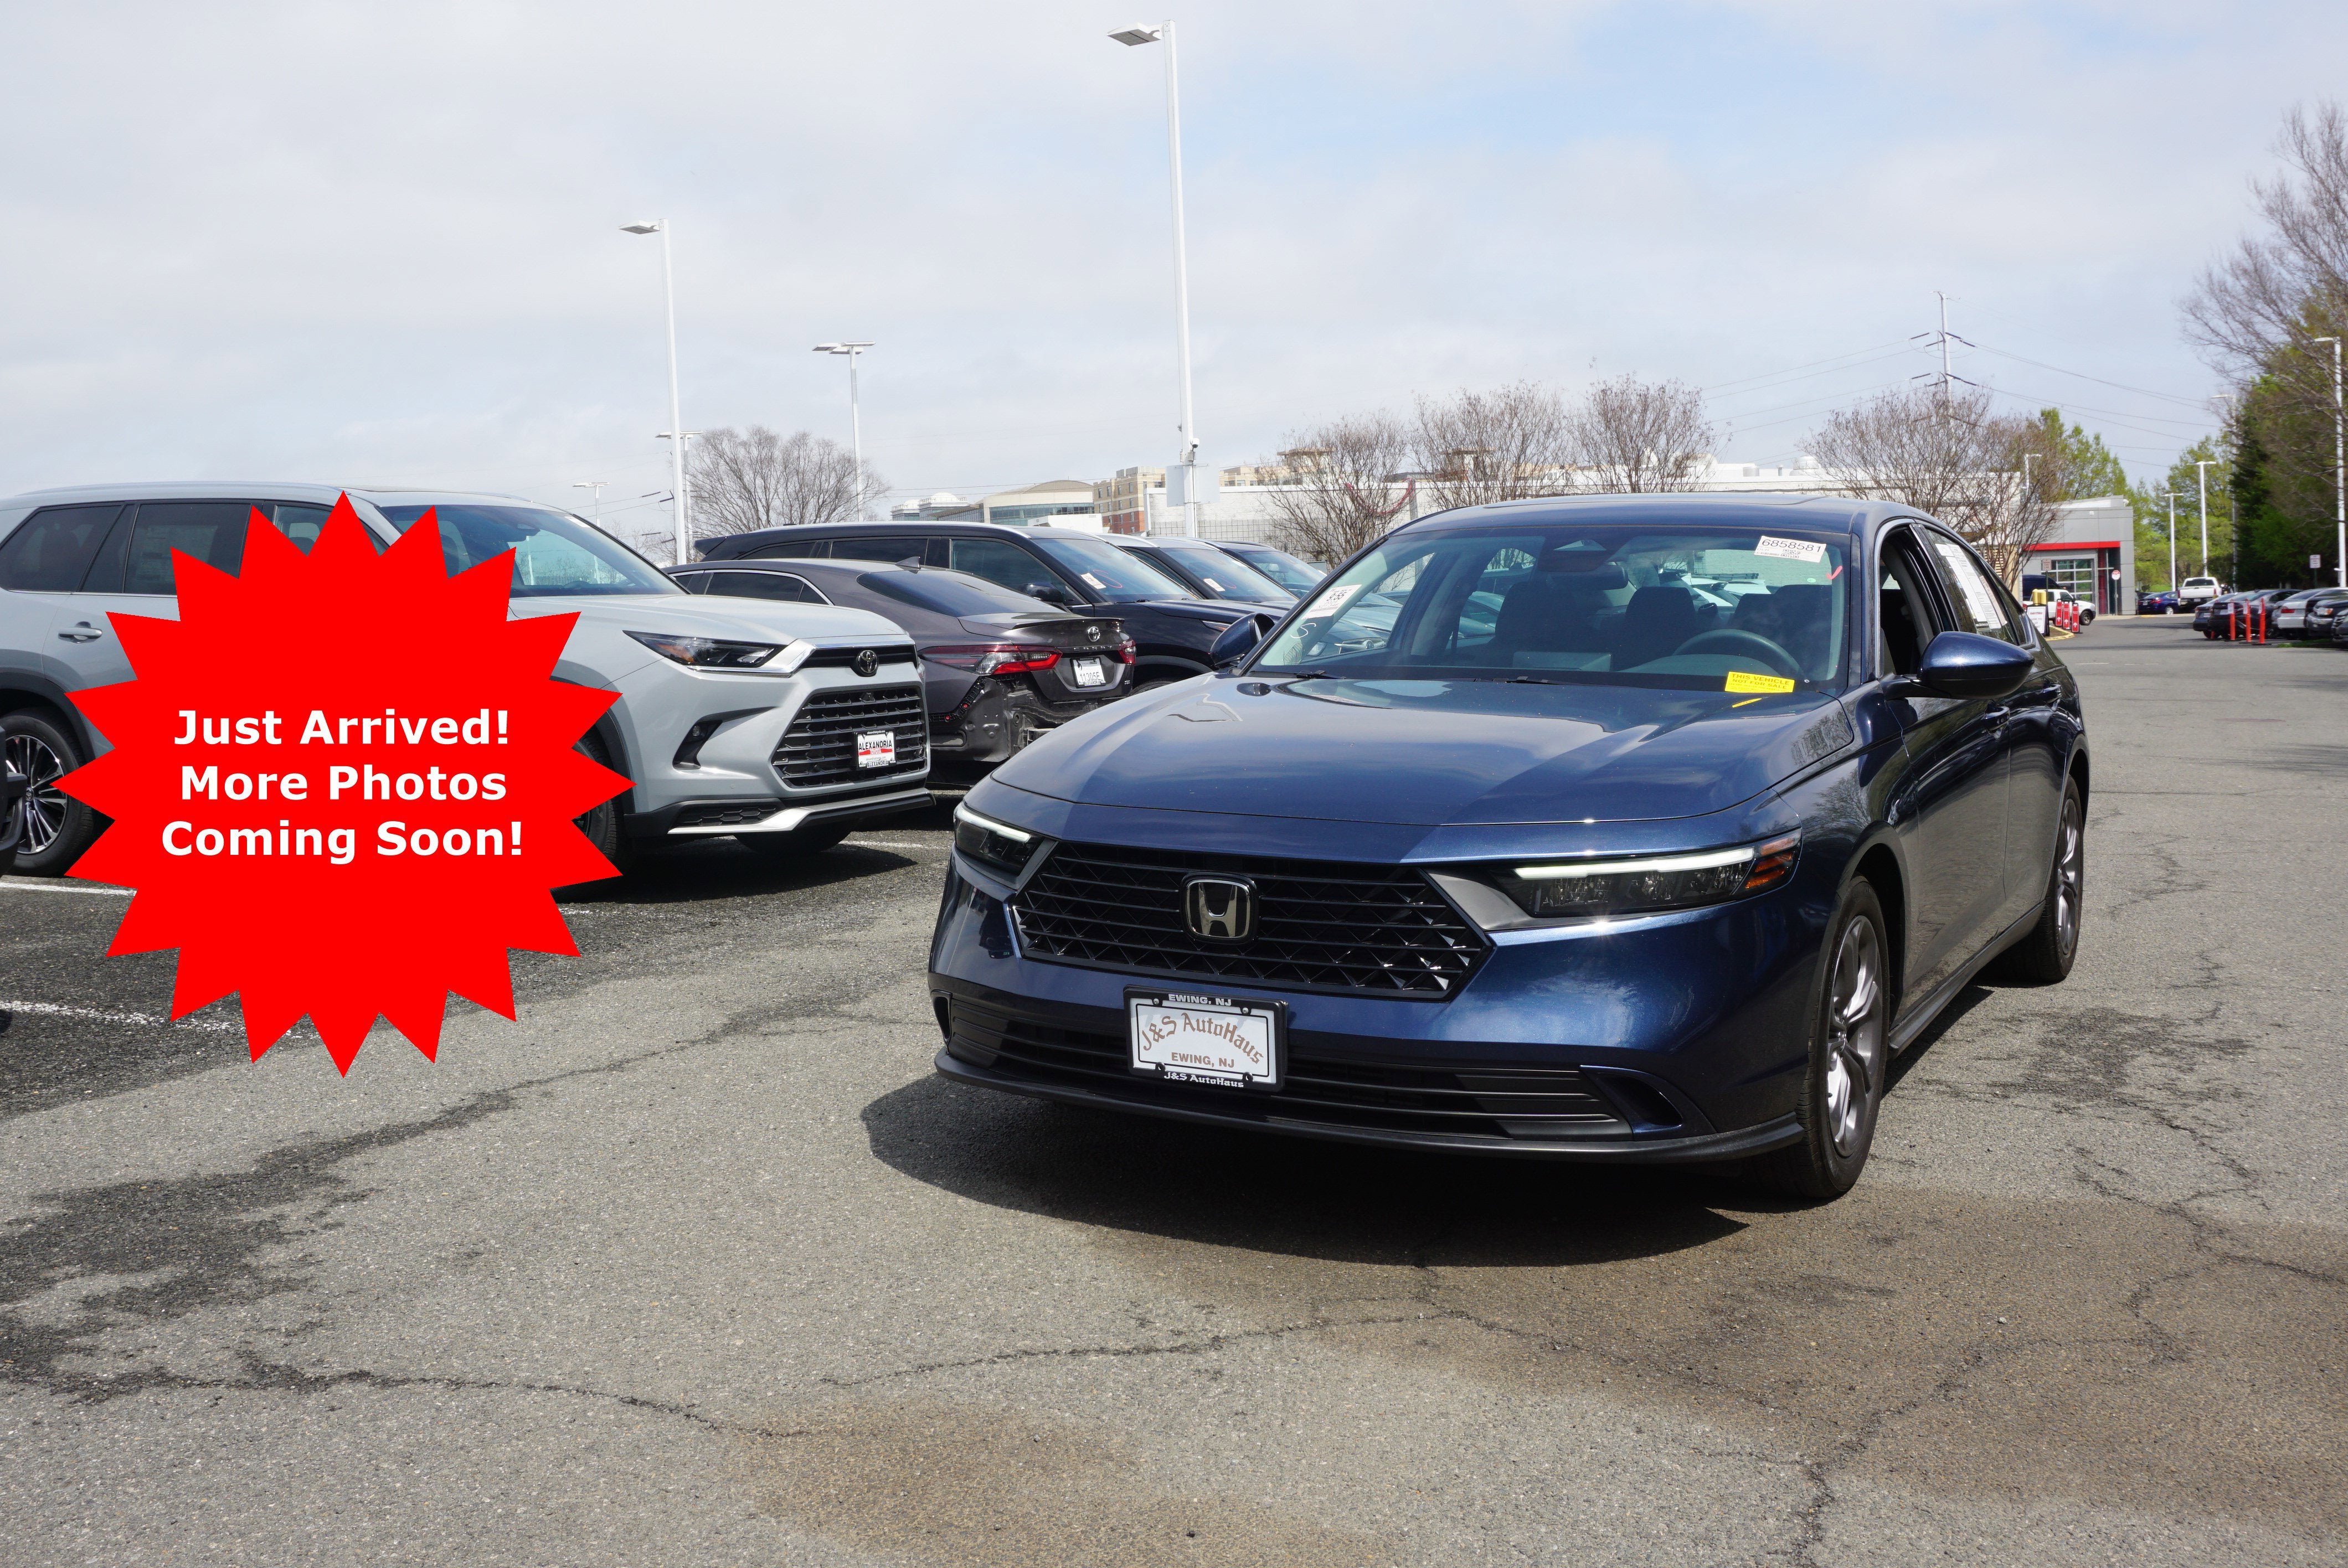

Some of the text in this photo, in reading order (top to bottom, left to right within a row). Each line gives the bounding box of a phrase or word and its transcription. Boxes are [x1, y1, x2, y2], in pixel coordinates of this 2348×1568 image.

[1762, 539, 1821, 552] 6858581
[1754, 676, 1790, 685] VEHICLE
[859, 740, 892, 750] ALEXANDRIA
[1168, 994, 1232, 1007] EWING, NJ
[1141, 1012, 1264, 1065] J&S AutoHaus
[1171, 1052, 1235, 1068] EWING, NJ
[1163, 1071, 1244, 1088] J&S AutoHaus
